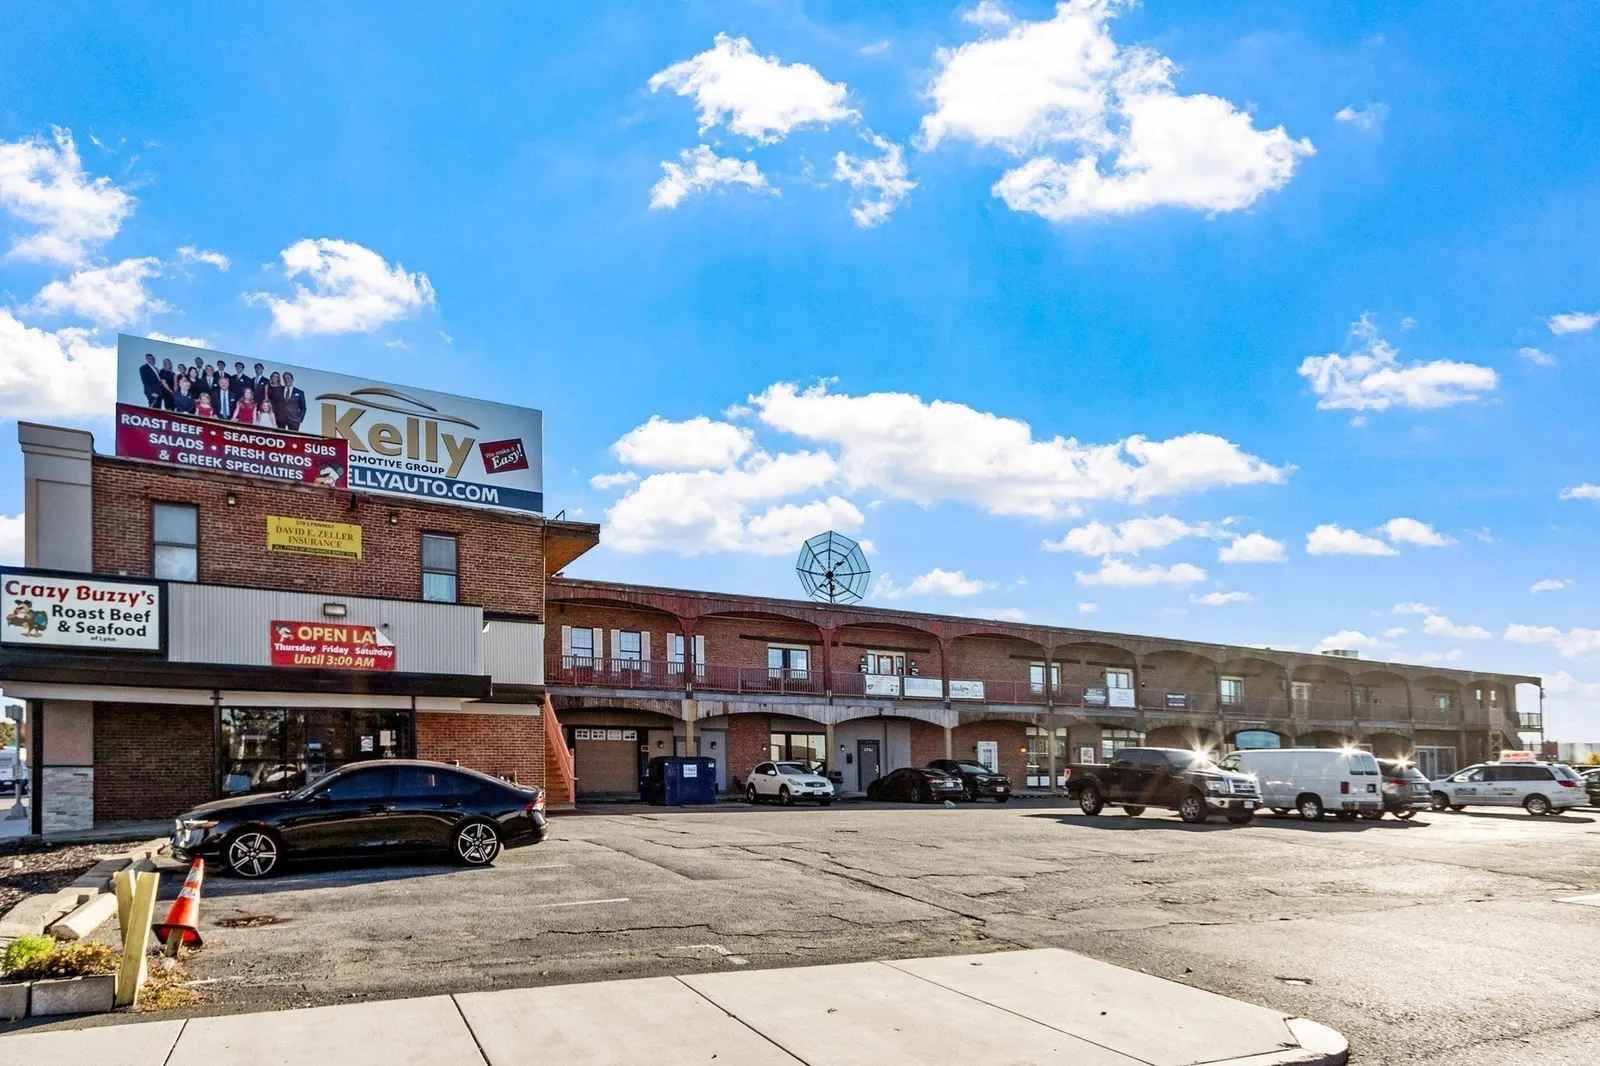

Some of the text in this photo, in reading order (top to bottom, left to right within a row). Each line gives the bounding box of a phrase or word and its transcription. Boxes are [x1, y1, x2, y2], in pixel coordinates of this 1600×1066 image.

[121, 413, 336, 457] ROAST BEEF SEAFOOD SUBS
[321, 403, 475, 479] Kelly
[149, 432, 312, 467] SALADS FRESH GYROS
[491, 443, 523, 470] Easy!
[158, 449, 304, 480] & GREEK SPECIALTIES
[405, 462, 445, 475] GROUP
[276, 525, 305, 535] DAVID
[317, 530, 354, 541] ZELLER
[288, 536, 343, 549] INSURANCE
[5, 580, 155, 608] Crazy Buzzy's
[52, 604, 151, 623] Roast Beef
[57, 620, 147, 637] & Seafood
[297, 626, 347, 642] OPEN
[274, 643, 393, 658] Thursday Friday Saturday
[294, 654, 375, 668] Until 3:00 AM
